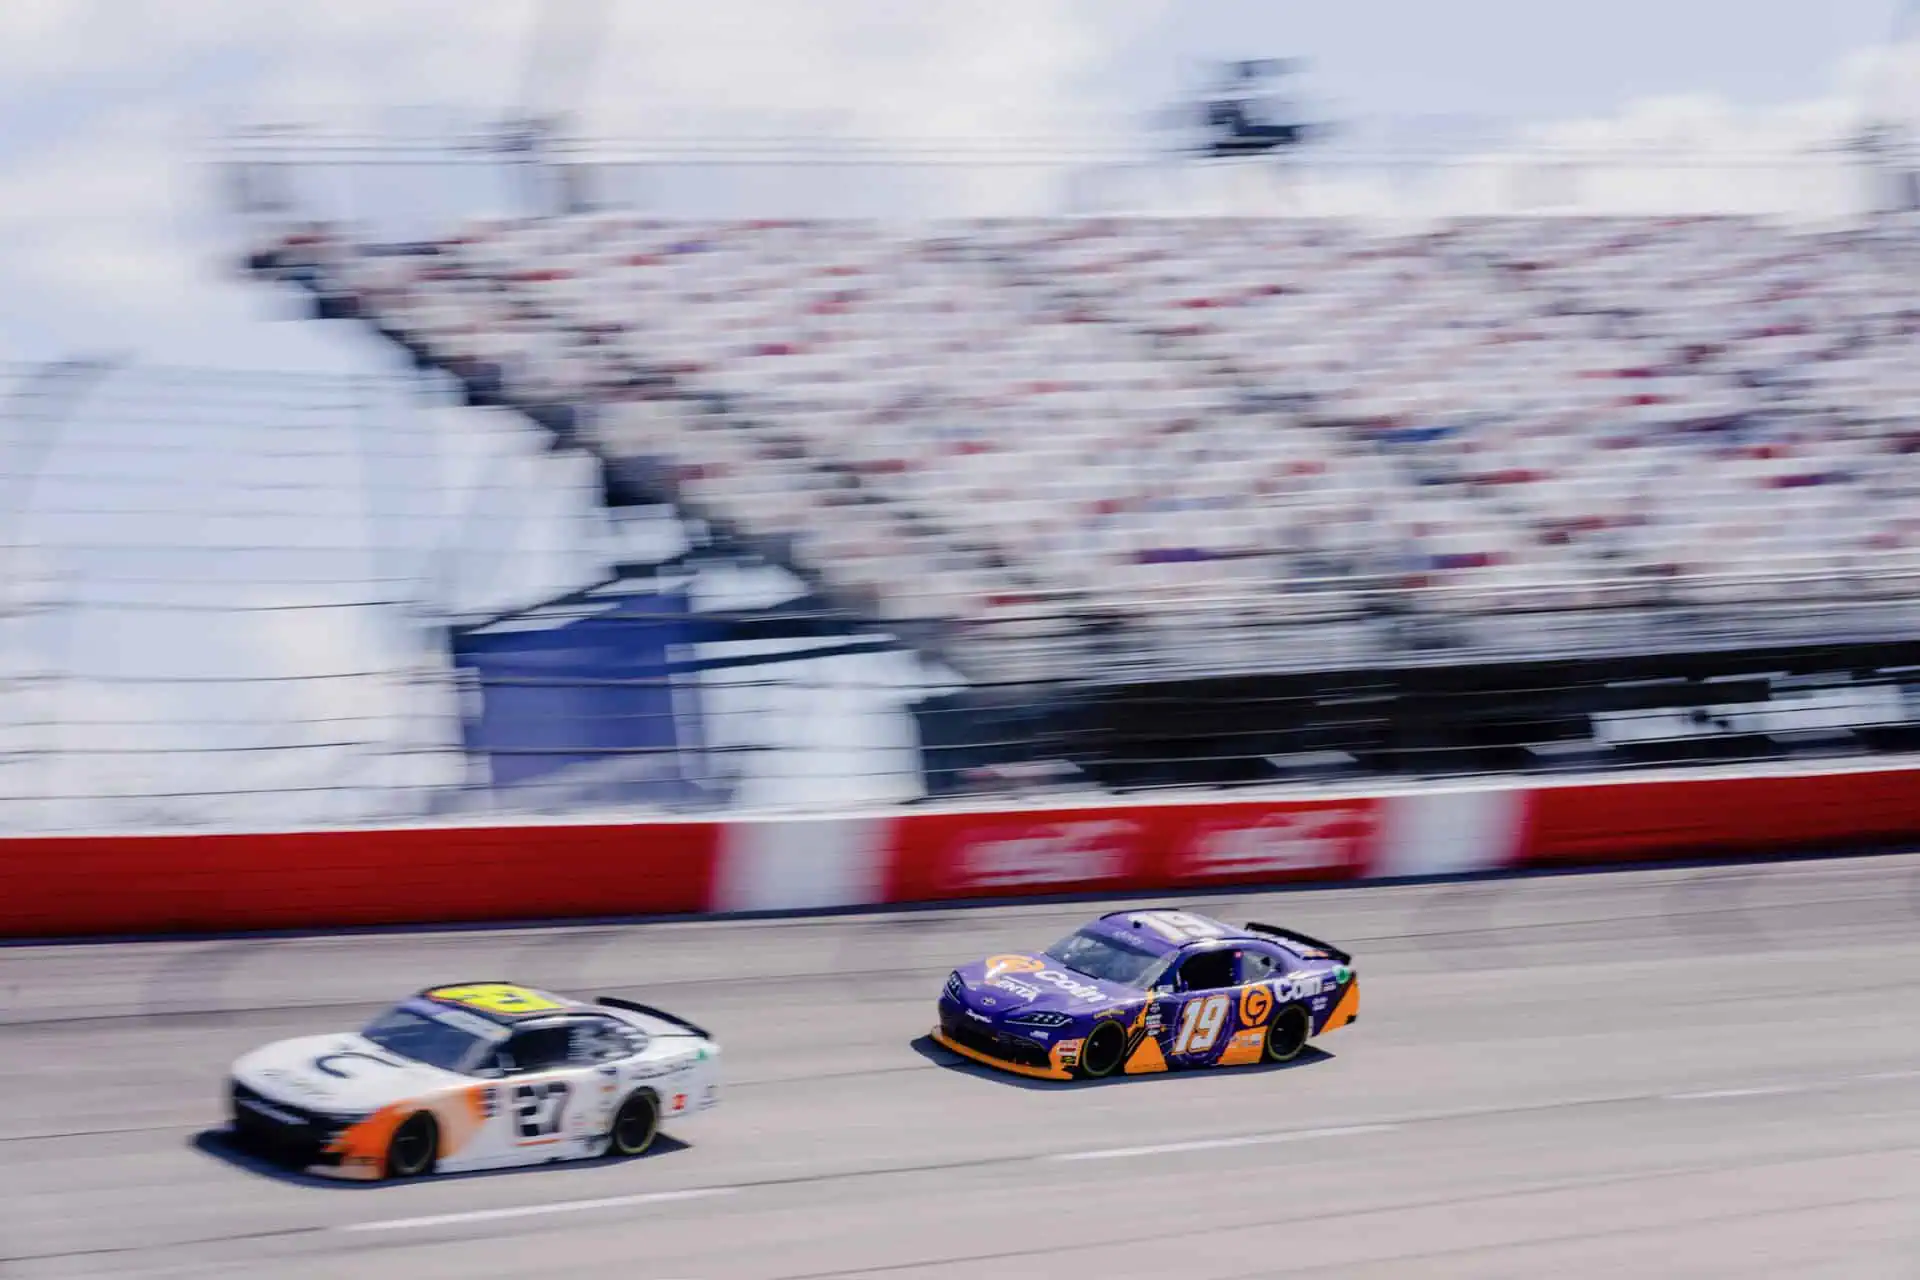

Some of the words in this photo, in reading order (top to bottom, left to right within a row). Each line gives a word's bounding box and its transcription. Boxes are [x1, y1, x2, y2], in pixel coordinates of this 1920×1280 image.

[1034, 970, 1108, 1003] Coin
[1171, 994, 1229, 1054] 19
[512, 1082, 571, 1137] 27
